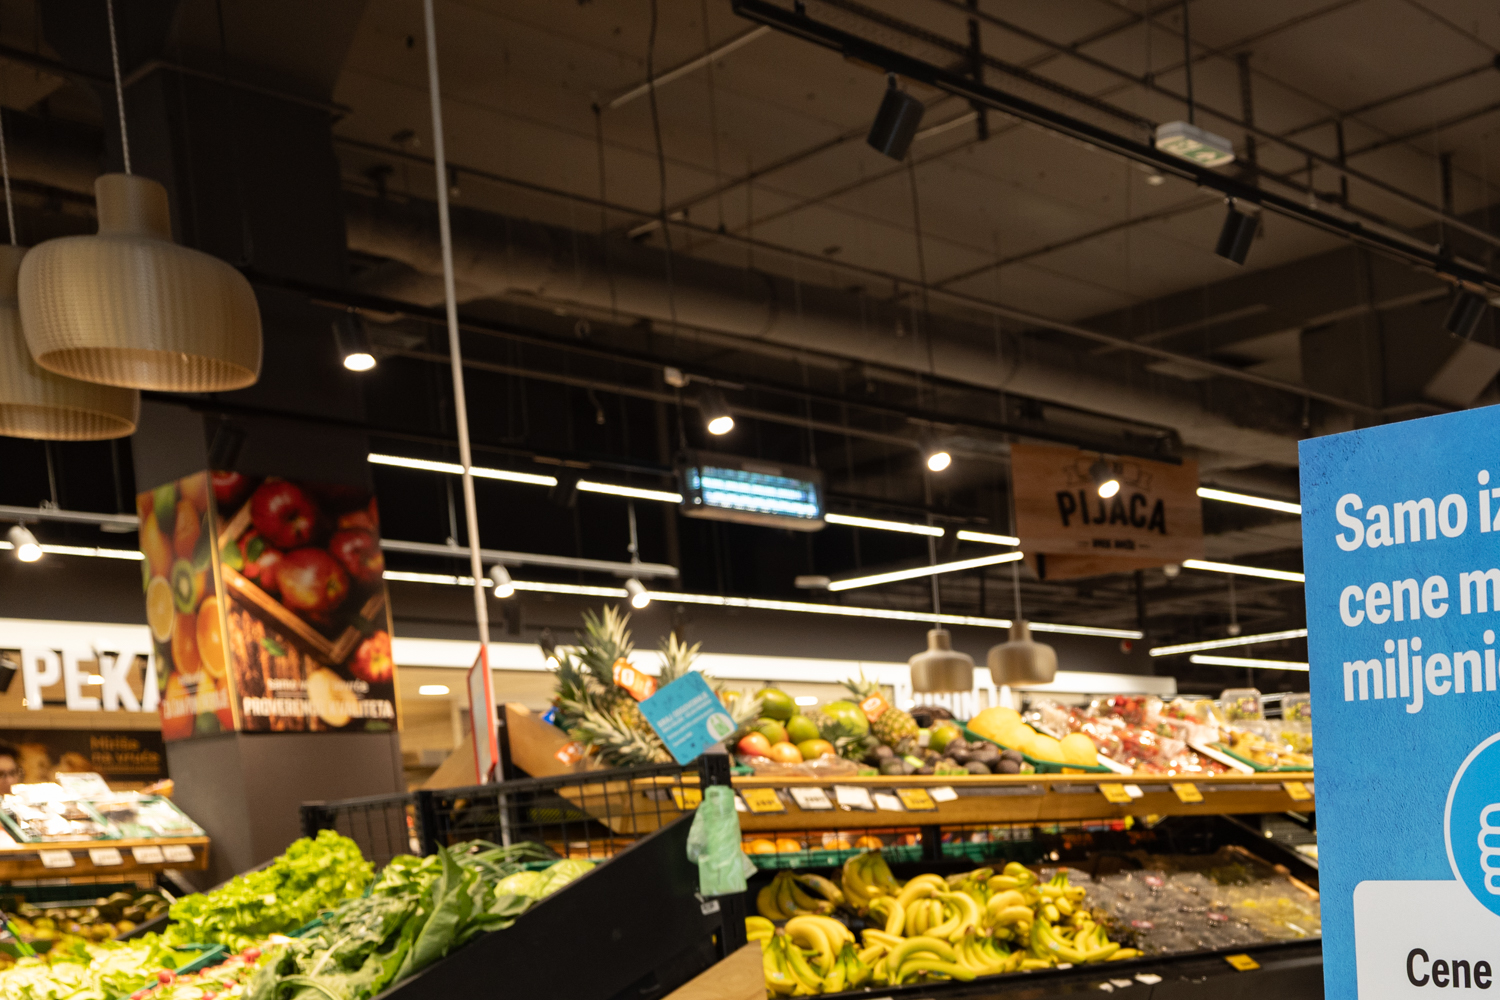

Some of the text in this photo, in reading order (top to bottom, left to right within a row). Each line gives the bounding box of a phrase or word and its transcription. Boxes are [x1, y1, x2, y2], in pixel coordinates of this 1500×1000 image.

[1056, 489, 1168, 535] PIJACA
[1335, 493, 1468, 552] Samo
[1338, 572, 1450, 628] cene
[1406, 948, 1493, 989] Cene
